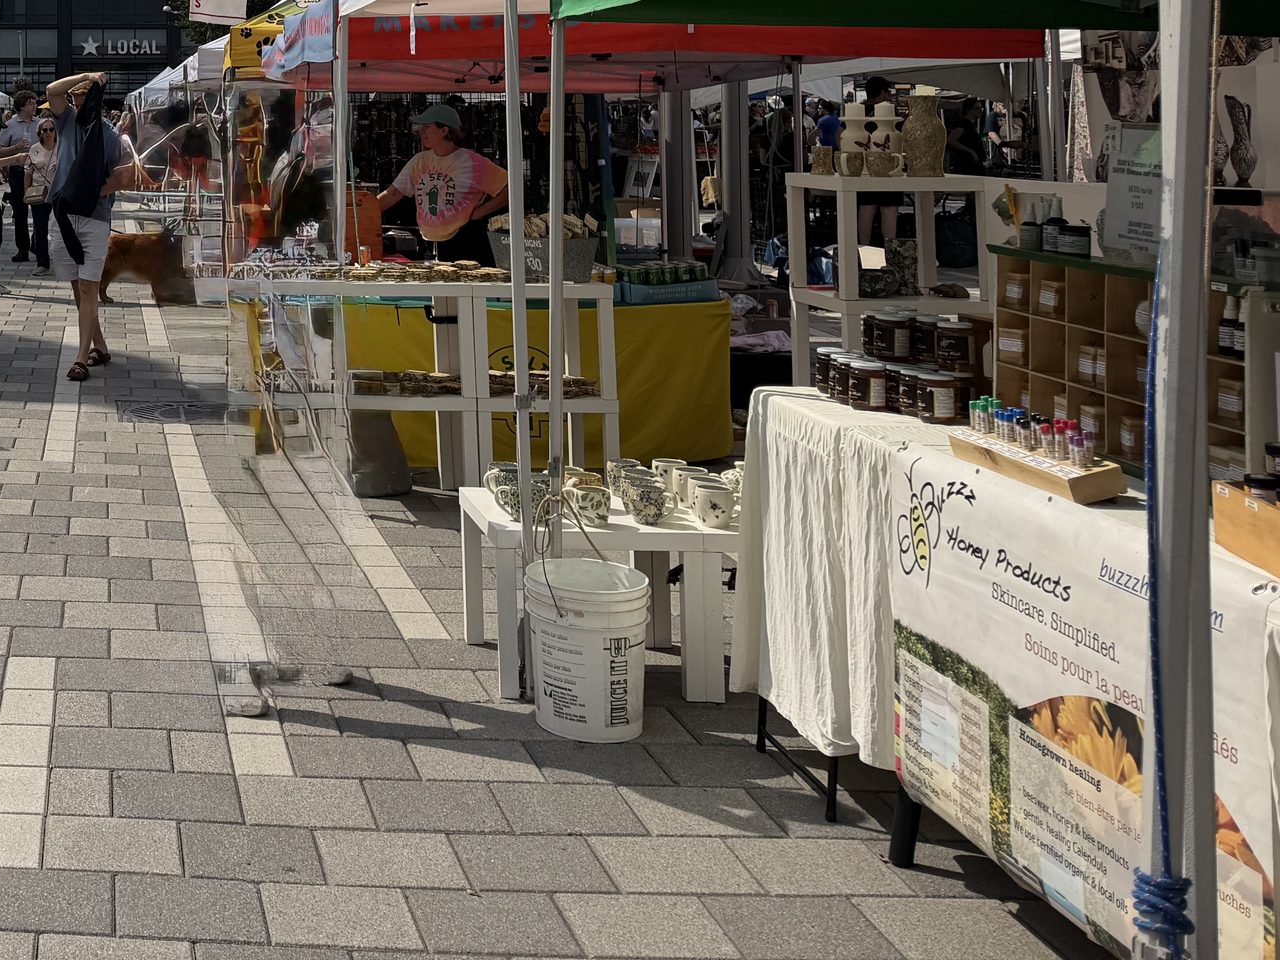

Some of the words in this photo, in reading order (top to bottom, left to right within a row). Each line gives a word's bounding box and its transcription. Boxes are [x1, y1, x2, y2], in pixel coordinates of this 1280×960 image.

[107, 39, 161, 55] LOCAL
[417, 177, 426, 206] CITY
[429, 172, 456, 206] SELTZER
[946, 526, 989, 570] Honey
[995, 548, 1072, 602] Products
[992, 582, 1047, 626] Skincare.
[1050, 611, 1120, 664] Simplified.
[609, 636, 631, 658] UP
[610, 659, 628, 676] IT
[904, 658, 919, 676] soaps
[1024, 632, 1058, 666] Soins
[1061, 654, 1093, 686] pour
[1095, 669, 1110, 694] la
[610, 678, 629, 726] JUICE
[904, 673, 924, 693] creams
[905, 734, 933, 762] deodorant
[1019, 728, 1068, 771] Homegrown
[1068, 758, 1102, 793] healing
[1022, 787, 1052, 817] beeswax,
[1052, 806, 1075, 834] honey
[1074, 823, 1081, 837] &
[1081, 827, 1096, 846] bee
[1097, 841, 1130, 871] products
[1075, 789, 1116, 826] bien-être
[1117, 819, 1133, 836] par
[1023, 806, 1044, 829] gentle,
[1045, 824, 1072, 852] healing
[1072, 841, 1108, 876] Calendula
[1013, 818, 1024, 835] We
[1024, 829, 1036, 843] use
[1036, 835, 1064, 865] certified
[1064, 858, 1092, 887] organic
[1091, 876, 1098, 890] &
[1098, 881, 1115, 904] local
[1115, 895, 1129, 916] oils
